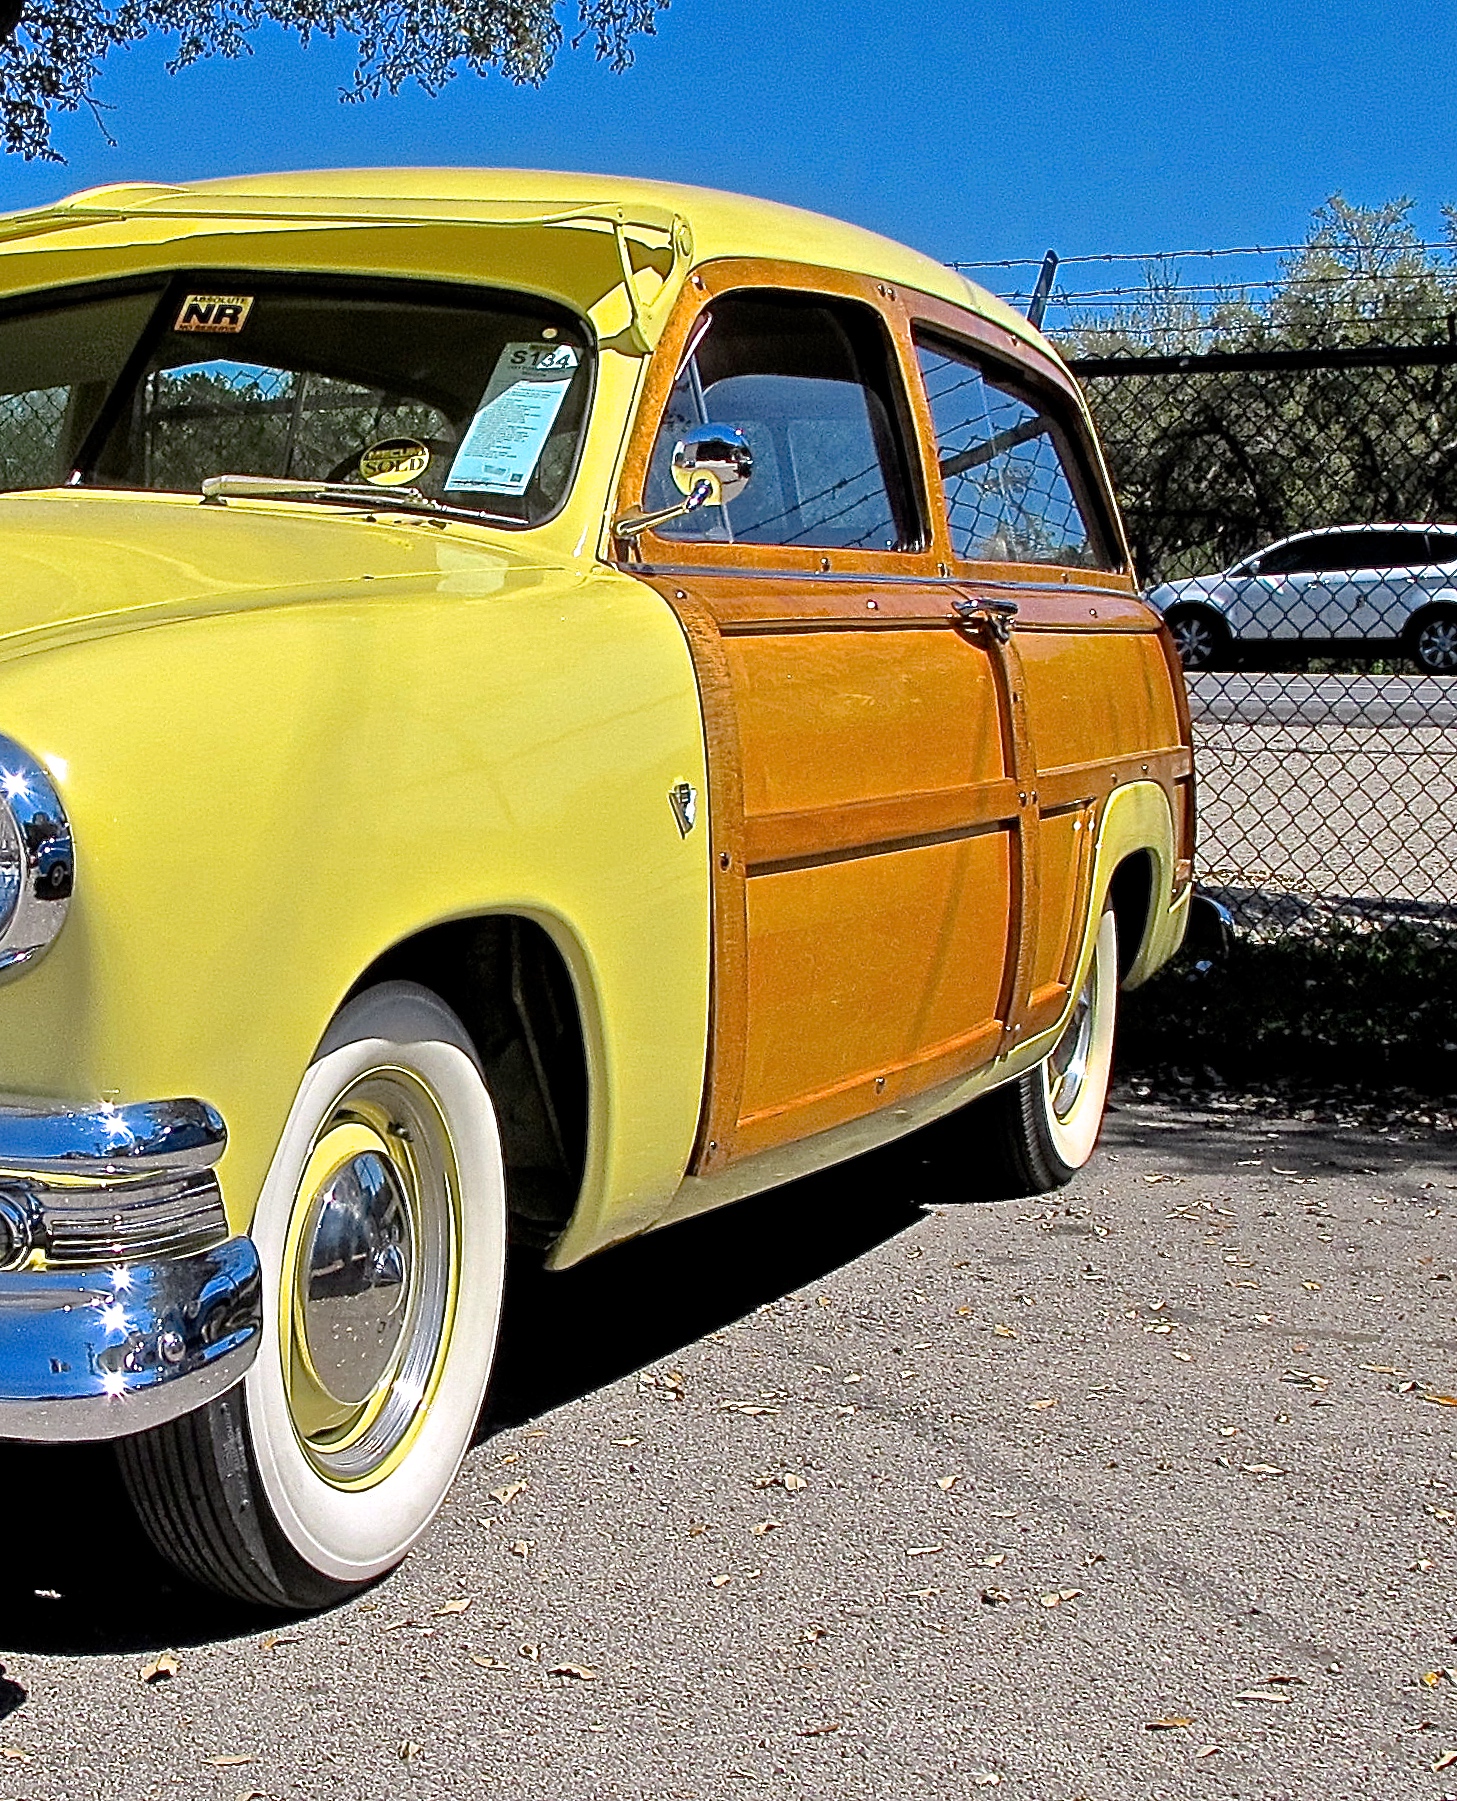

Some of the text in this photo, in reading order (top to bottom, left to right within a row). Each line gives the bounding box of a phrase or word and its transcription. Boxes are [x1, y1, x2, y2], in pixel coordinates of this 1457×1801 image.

[182, 303, 243, 325] NR
[510, 350, 571, 369] S134
[368, 446, 424, 460] MECUM
[364, 457, 425, 475] SOLD
